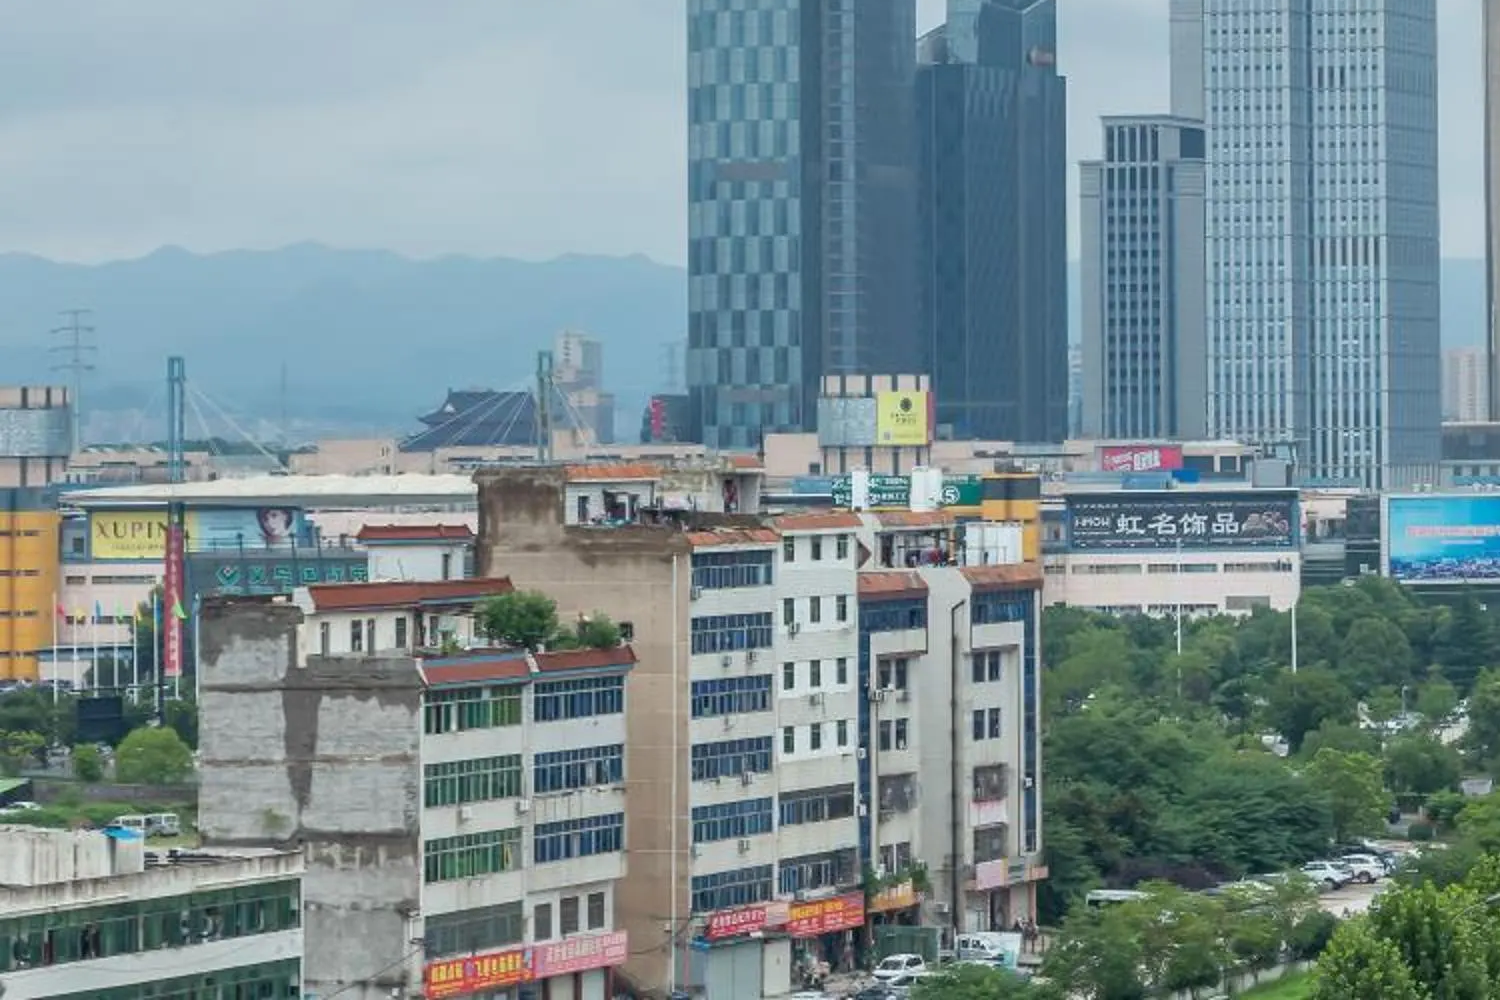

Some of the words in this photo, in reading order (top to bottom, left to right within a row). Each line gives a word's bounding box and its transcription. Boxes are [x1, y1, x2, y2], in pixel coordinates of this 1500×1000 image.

[95, 520, 168, 539] XUPIN
[1115, 511, 1240, 535] 虹名饰品
